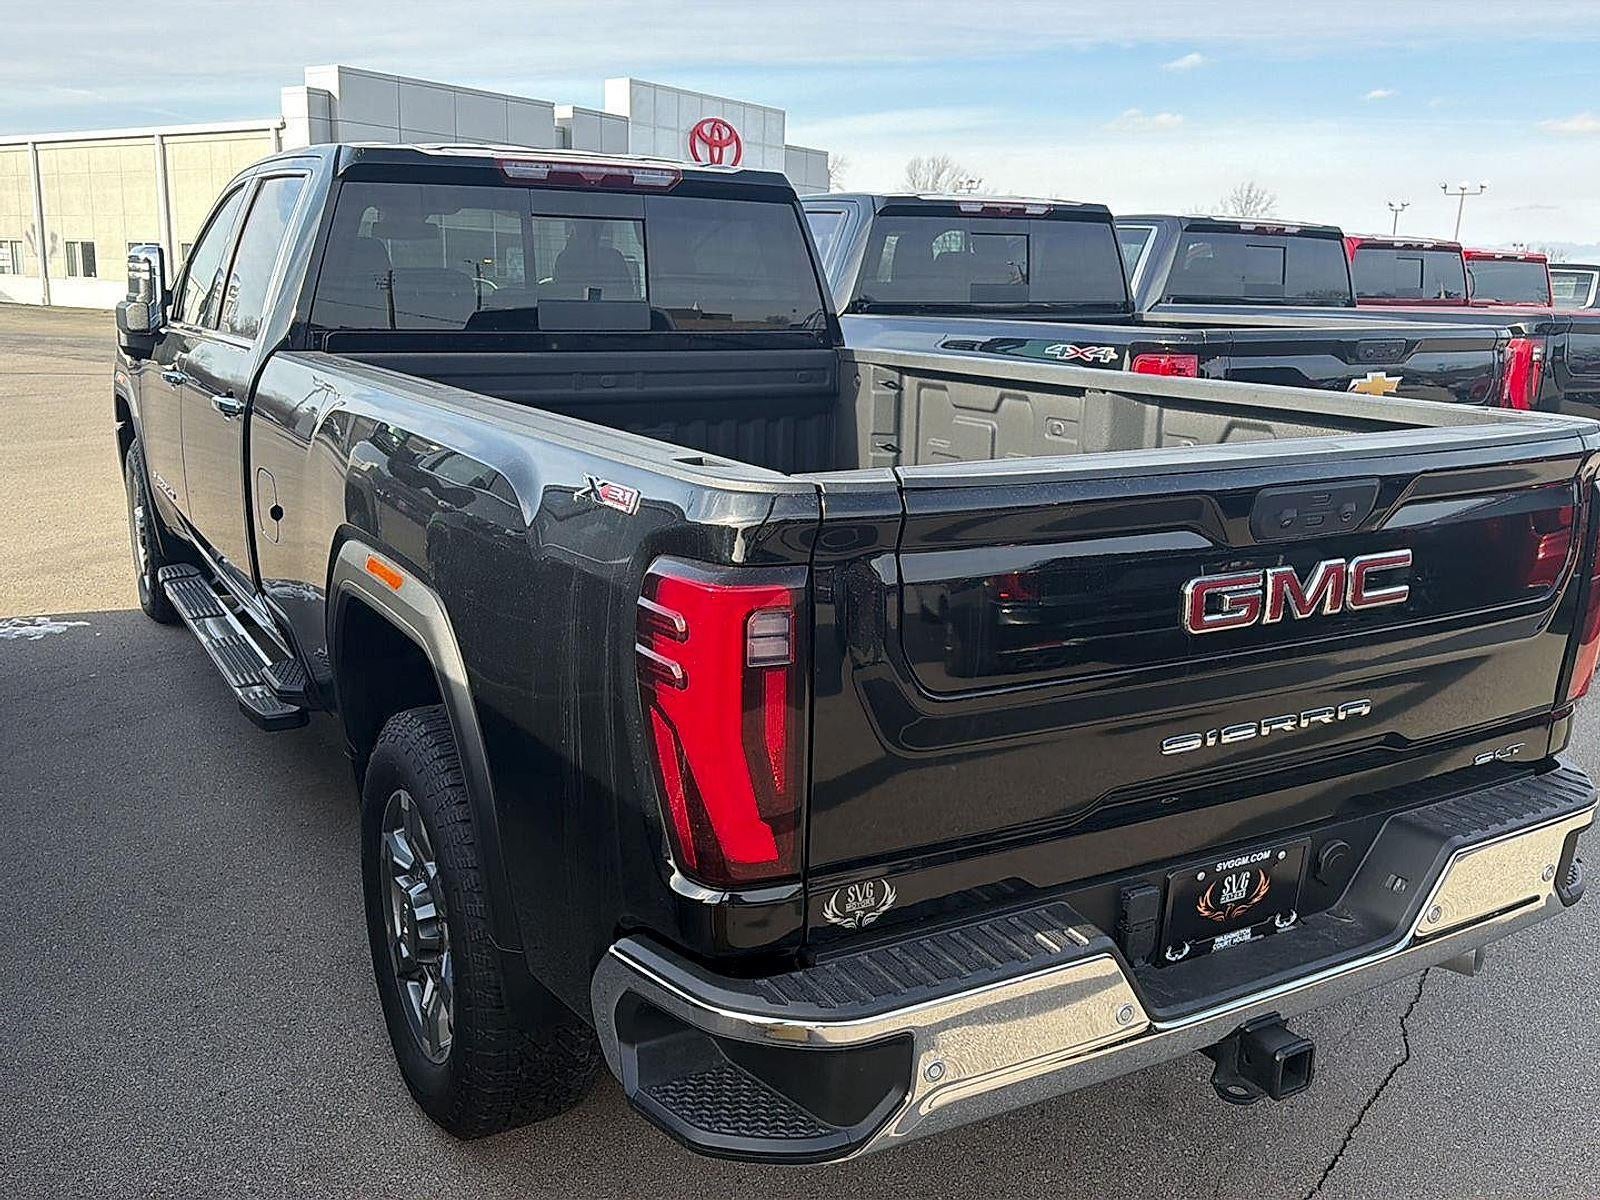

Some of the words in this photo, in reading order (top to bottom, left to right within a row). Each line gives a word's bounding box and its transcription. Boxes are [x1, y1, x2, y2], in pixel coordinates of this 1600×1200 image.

[1182, 548, 1414, 635] GMC
[1160, 698, 1373, 756] SIERRA
[1472, 741, 1527, 766] SLT
[1215, 850, 1271, 872] SVGGM.COM
[847, 881, 874, 903] SVG
[1222, 871, 1251, 894] SVG
